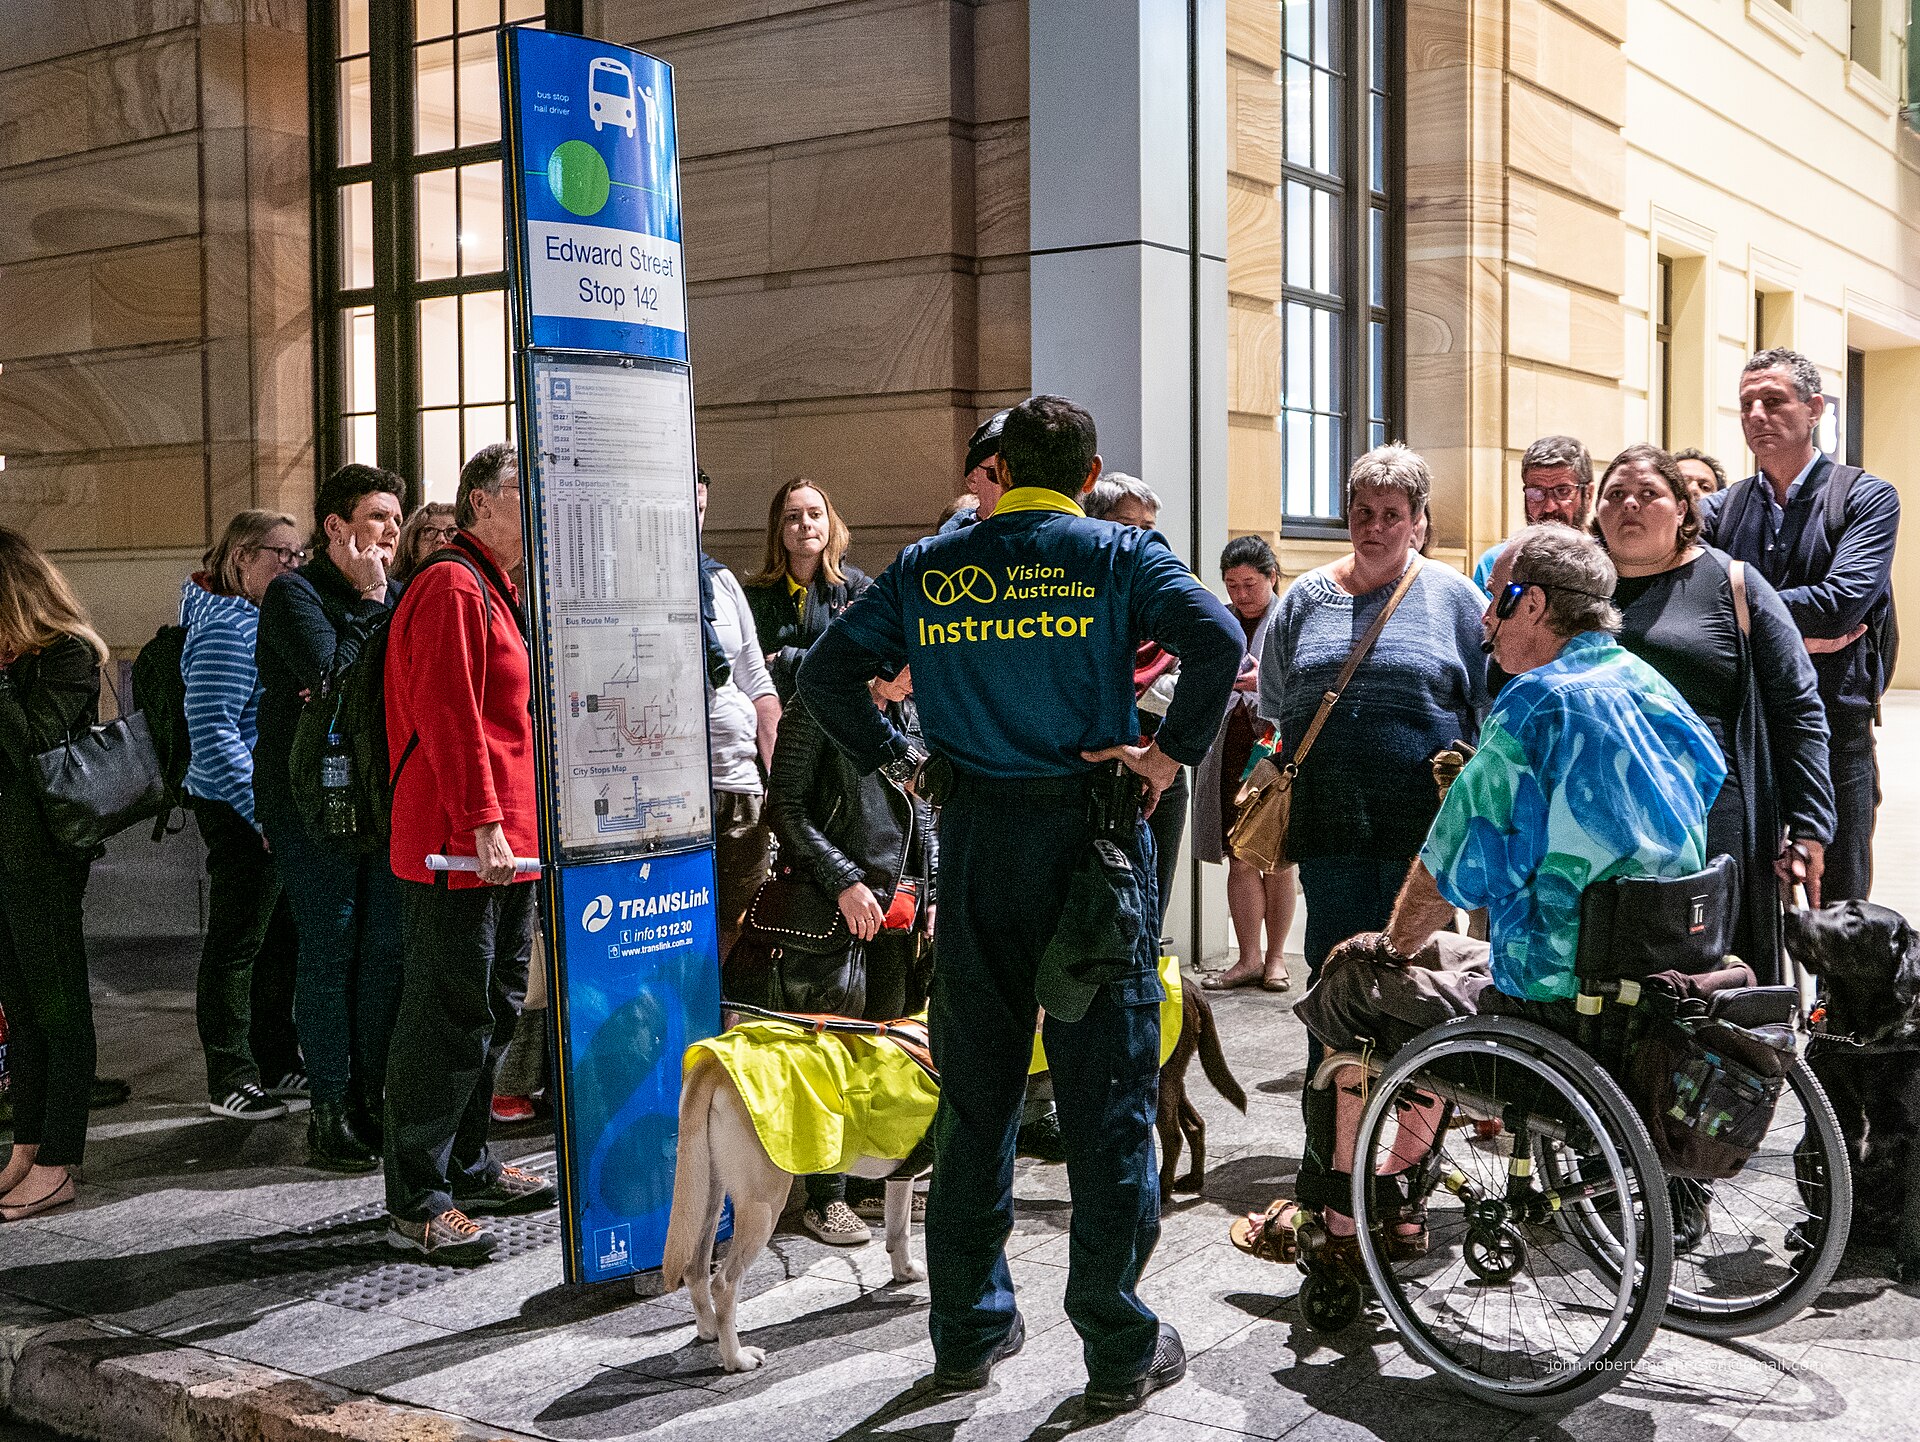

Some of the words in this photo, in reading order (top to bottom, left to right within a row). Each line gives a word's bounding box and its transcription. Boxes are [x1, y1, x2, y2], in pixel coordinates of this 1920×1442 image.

[537, 90, 551, 99] bus
[552, 93, 570, 103] stop
[533, 104, 548, 113] hail
[549, 106, 570, 116] driver
[546, 235, 622, 267] Edward
[630, 246, 674, 277] Street
[579, 277, 625, 311] Stop
[633, 285, 658, 311] 142
[560, 479, 573, 487] Bus
[574, 480, 610, 489] Departure
[1006, 563, 1065, 581] Vision
[1003, 582, 1096, 601] Australia
[566, 617, 579, 625] Bus
[604, 616, 619, 625] Map
[918, 611, 1095, 646] Instructor
[573, 767, 588, 777] City
[590, 766, 610, 775] Stops
[611, 765, 627, 774] Map
[619, 886, 710, 920] TRANSLink
[634, 927, 654, 942] info
[621, 937, 693, 957] www.translink.com.au
